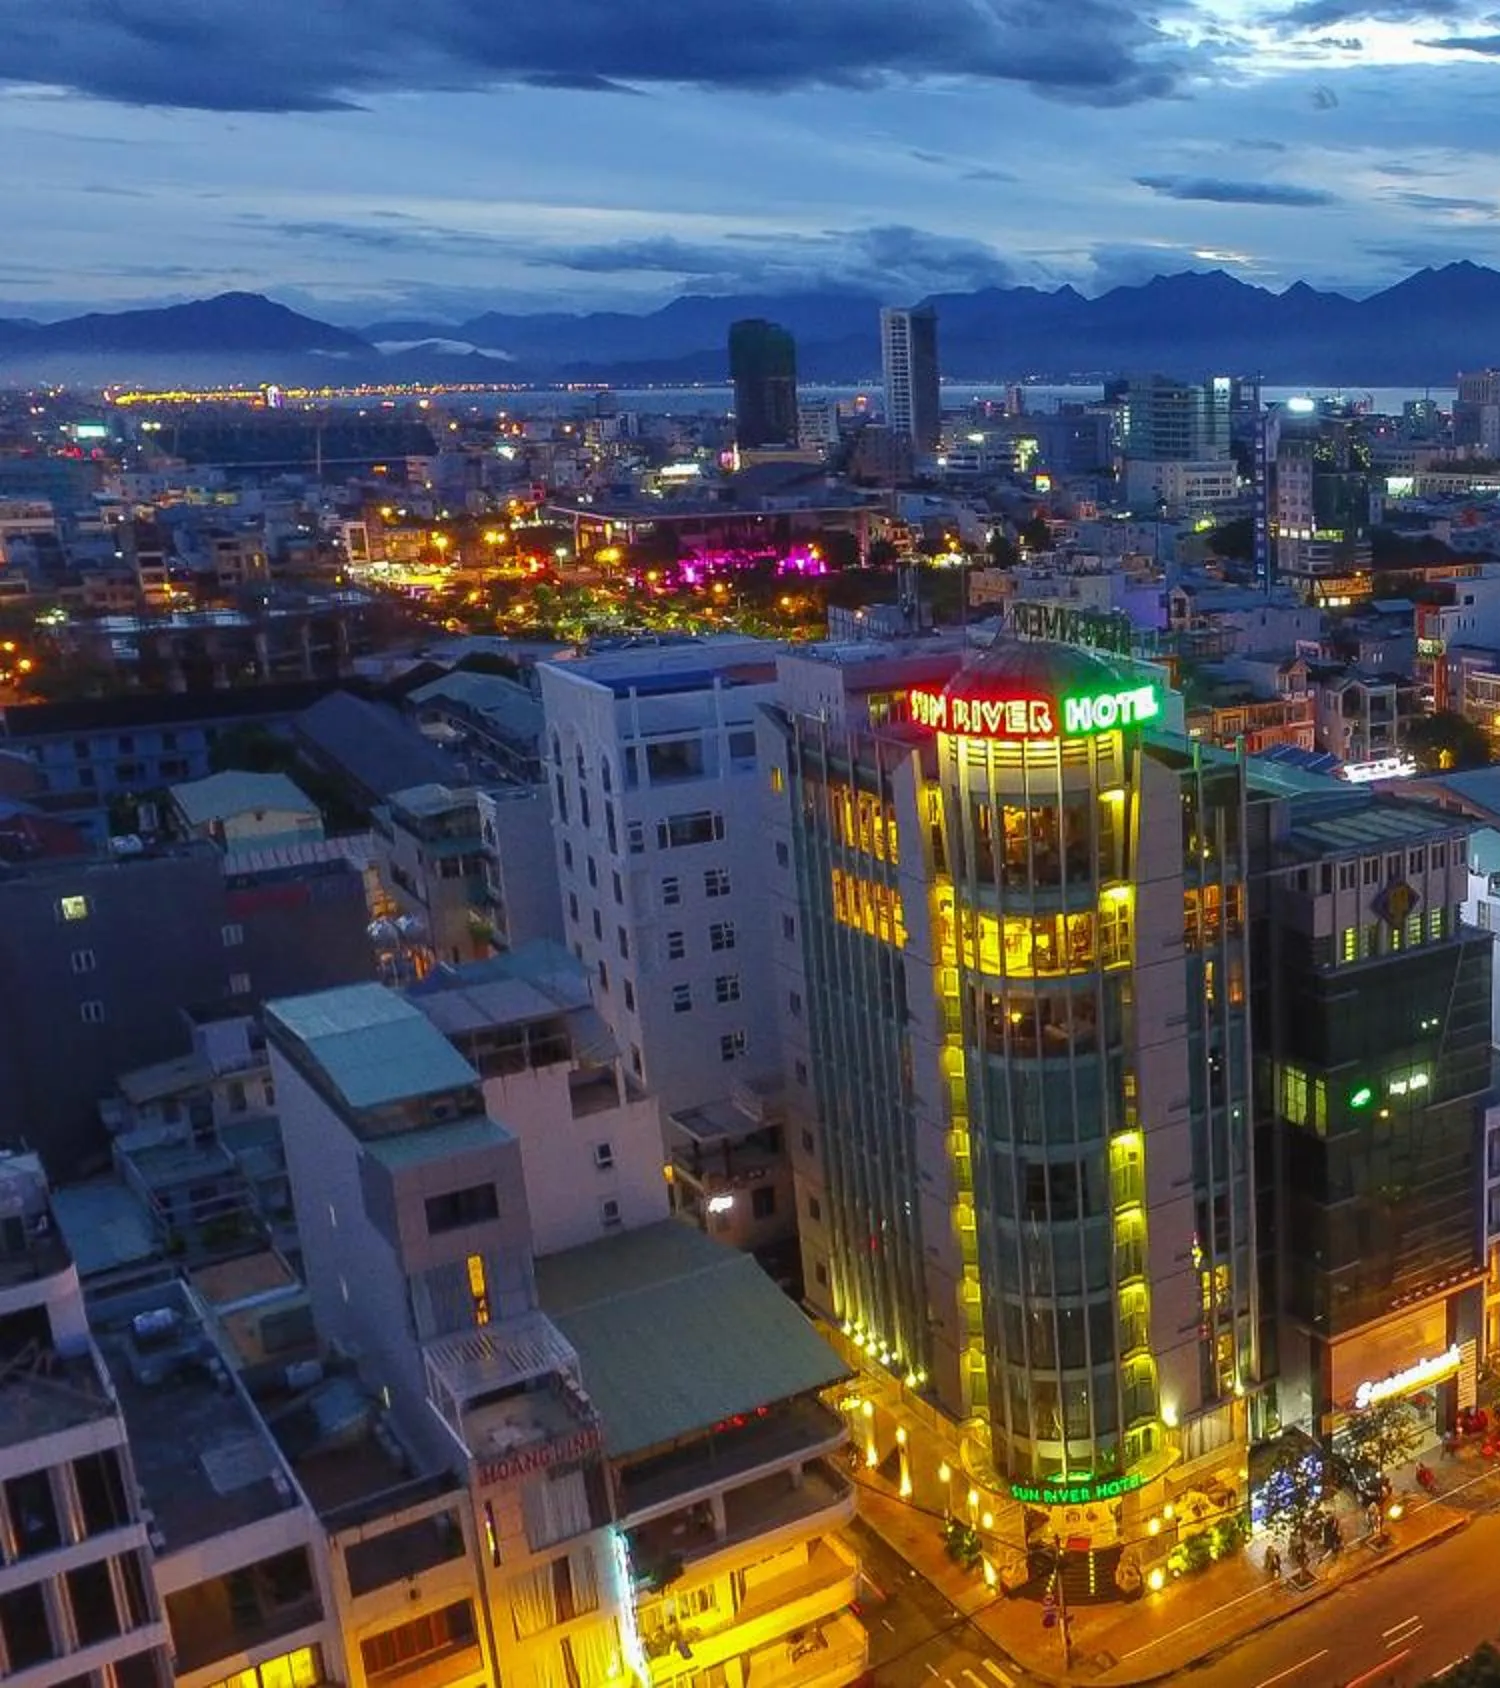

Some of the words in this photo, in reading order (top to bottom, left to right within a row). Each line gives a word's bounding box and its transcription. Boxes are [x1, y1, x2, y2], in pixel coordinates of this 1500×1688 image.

[953, 700, 1053, 734] RIVER
[1064, 684, 1159, 732] HOTEL
[1011, 1484, 1039, 1501] SUN
[1043, 1488, 1090, 1502] RIVER
[1096, 1473, 1148, 1498] HOTEL
